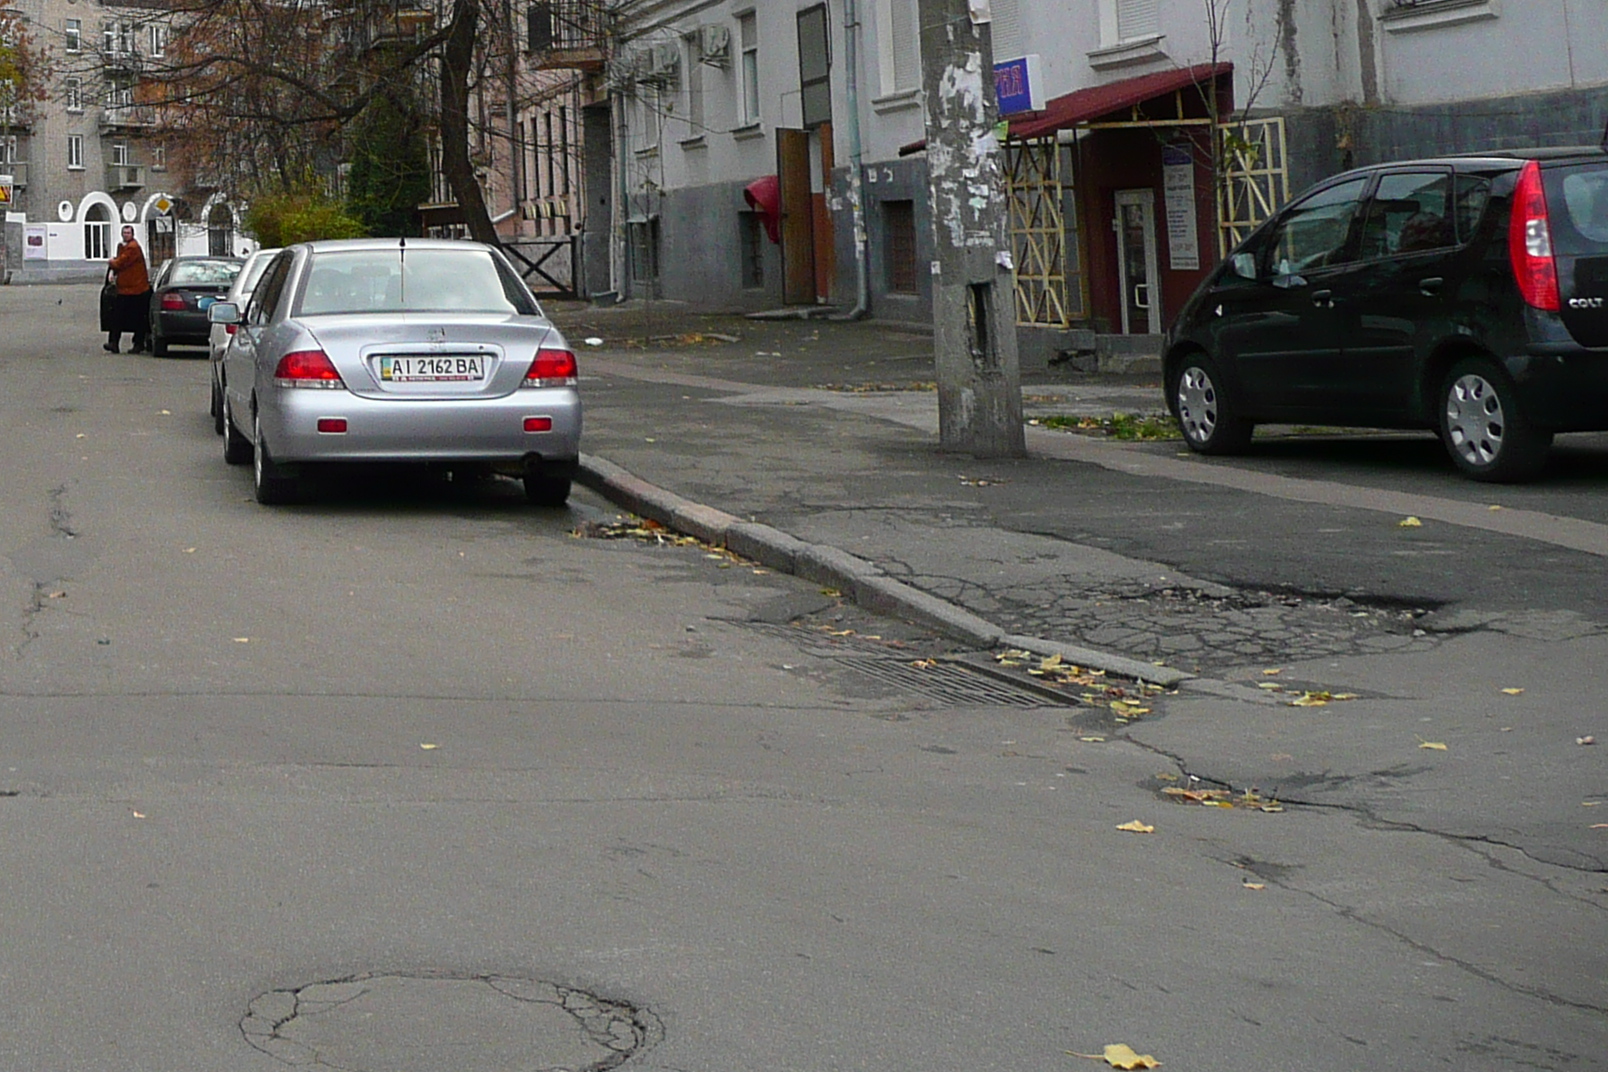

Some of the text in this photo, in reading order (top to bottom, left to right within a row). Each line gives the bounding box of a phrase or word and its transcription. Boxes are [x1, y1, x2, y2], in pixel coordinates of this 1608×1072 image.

[1569, 298, 1603, 308] COLT
[392, 359, 479, 374] AI 2162 BA
